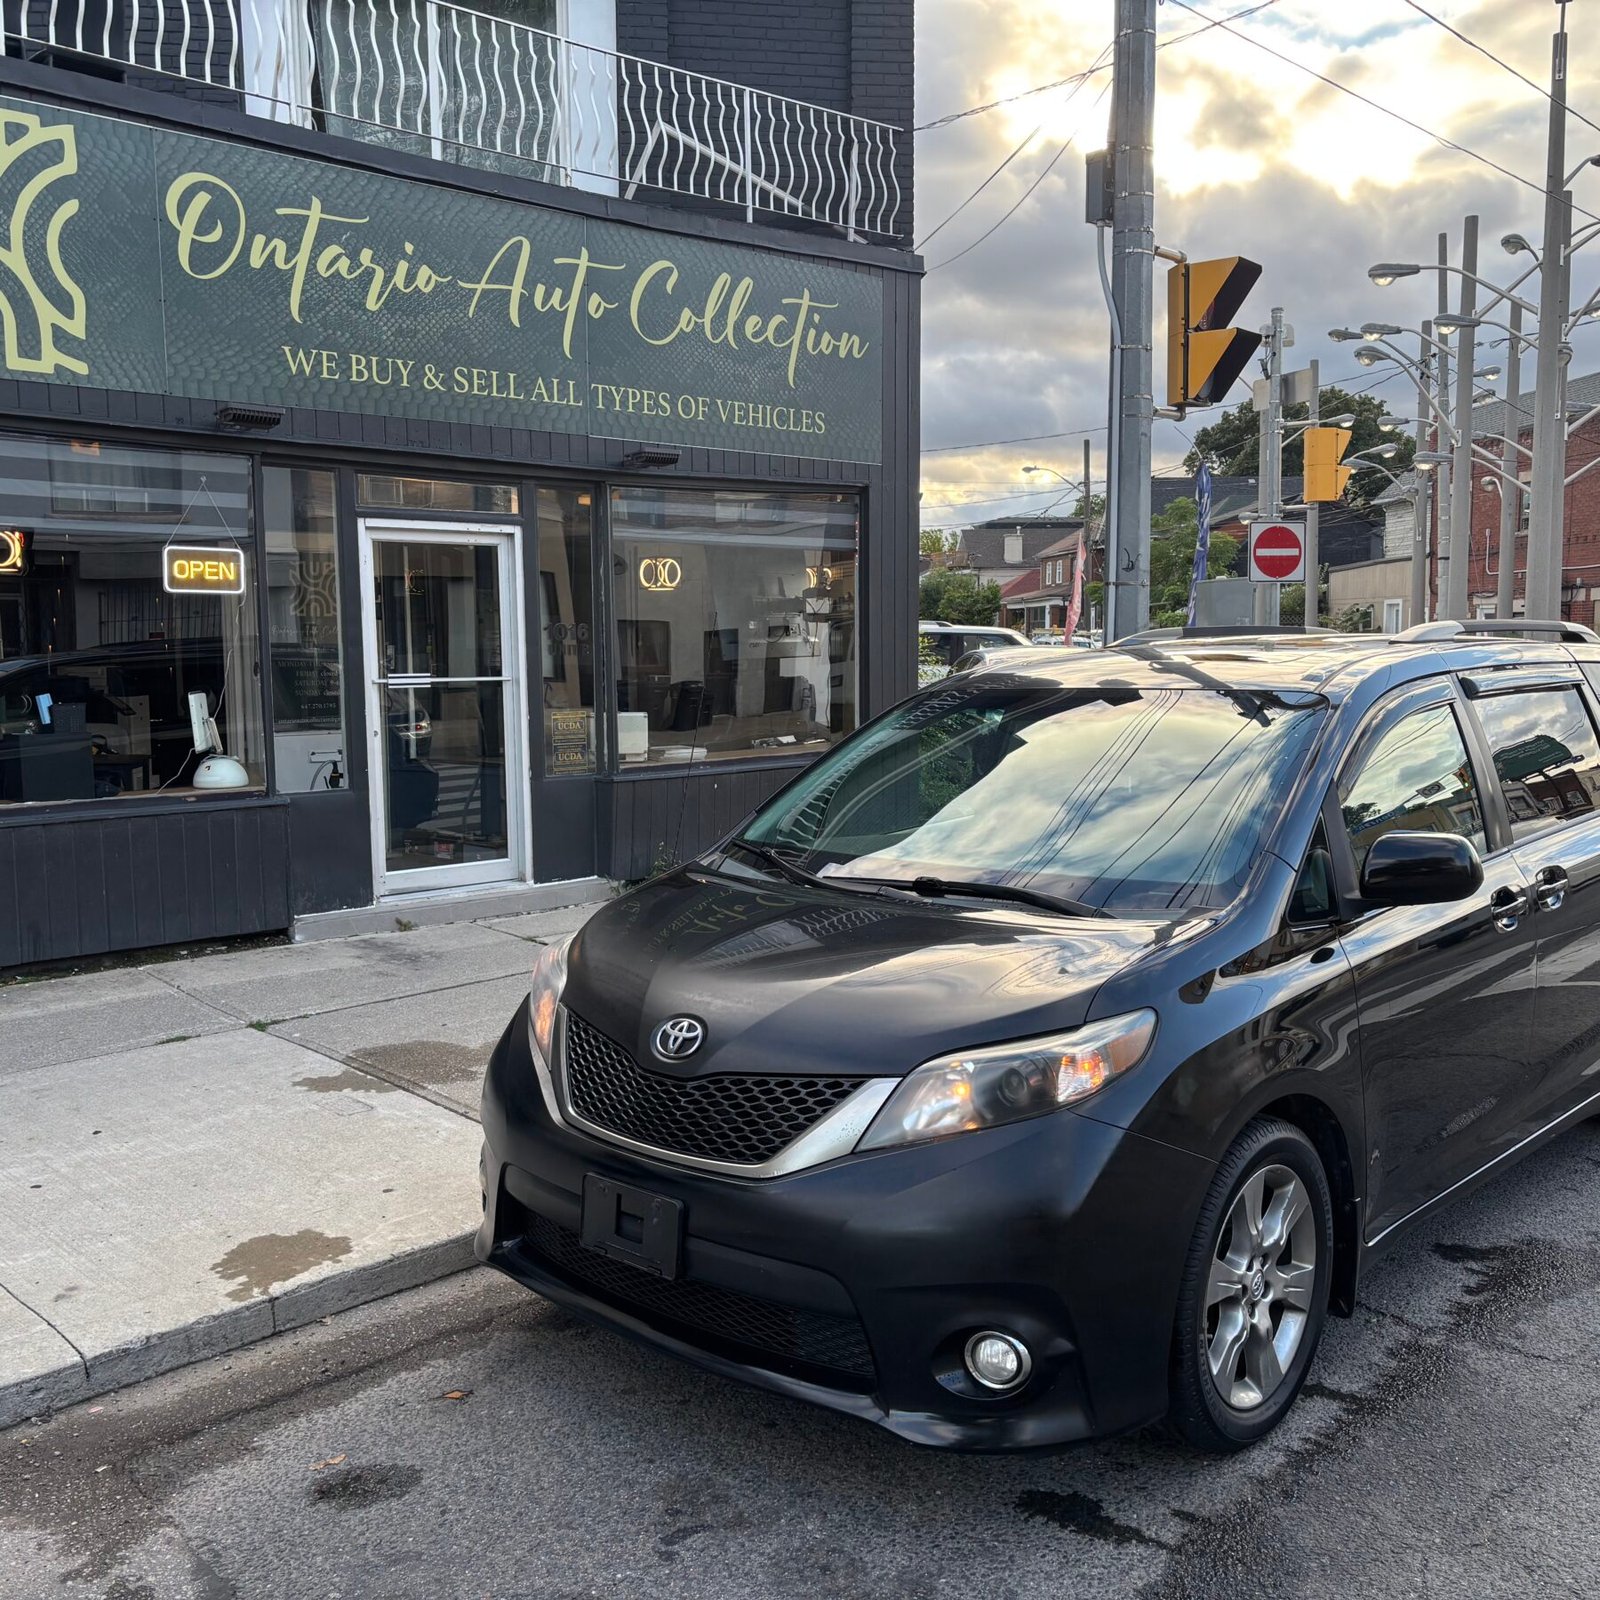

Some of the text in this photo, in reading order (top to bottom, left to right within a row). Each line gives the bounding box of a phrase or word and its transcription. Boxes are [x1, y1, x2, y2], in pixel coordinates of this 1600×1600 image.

[165, 172, 869, 389] Ontario Auto Collection
[281, 346, 826, 434] WE BUY & SELL ALL TYPES OF VEHICLES
[172, 559, 236, 581] OPEN
[557, 721, 582, 730] UCDA
[558, 752, 583, 761] UCDA
